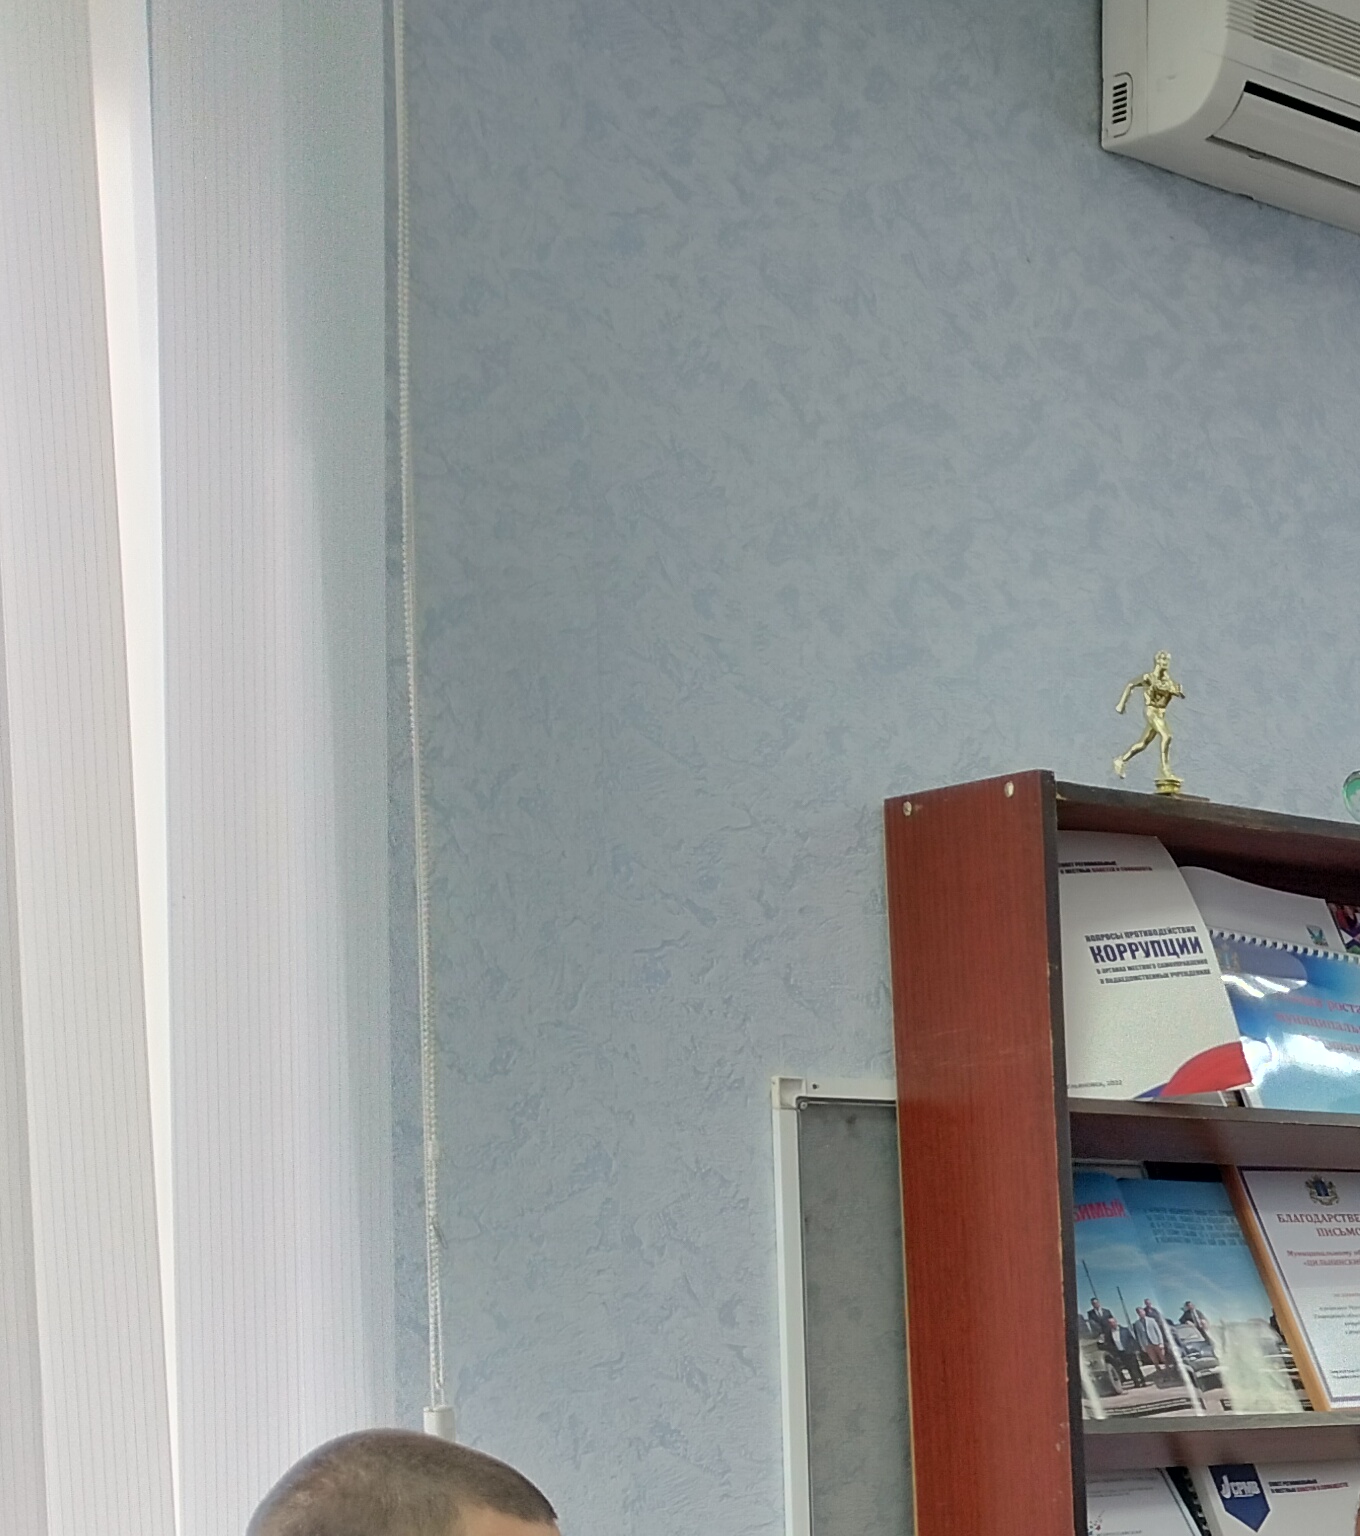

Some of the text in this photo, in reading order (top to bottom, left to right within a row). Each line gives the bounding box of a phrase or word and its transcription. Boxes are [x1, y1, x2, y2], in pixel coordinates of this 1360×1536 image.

[1085, 926, 1197, 943] ВОПРОСЫ ПРОТИВОДЕЙСТВИЯ
[1089, 936, 1204, 964] КОРРУПЦИИ
